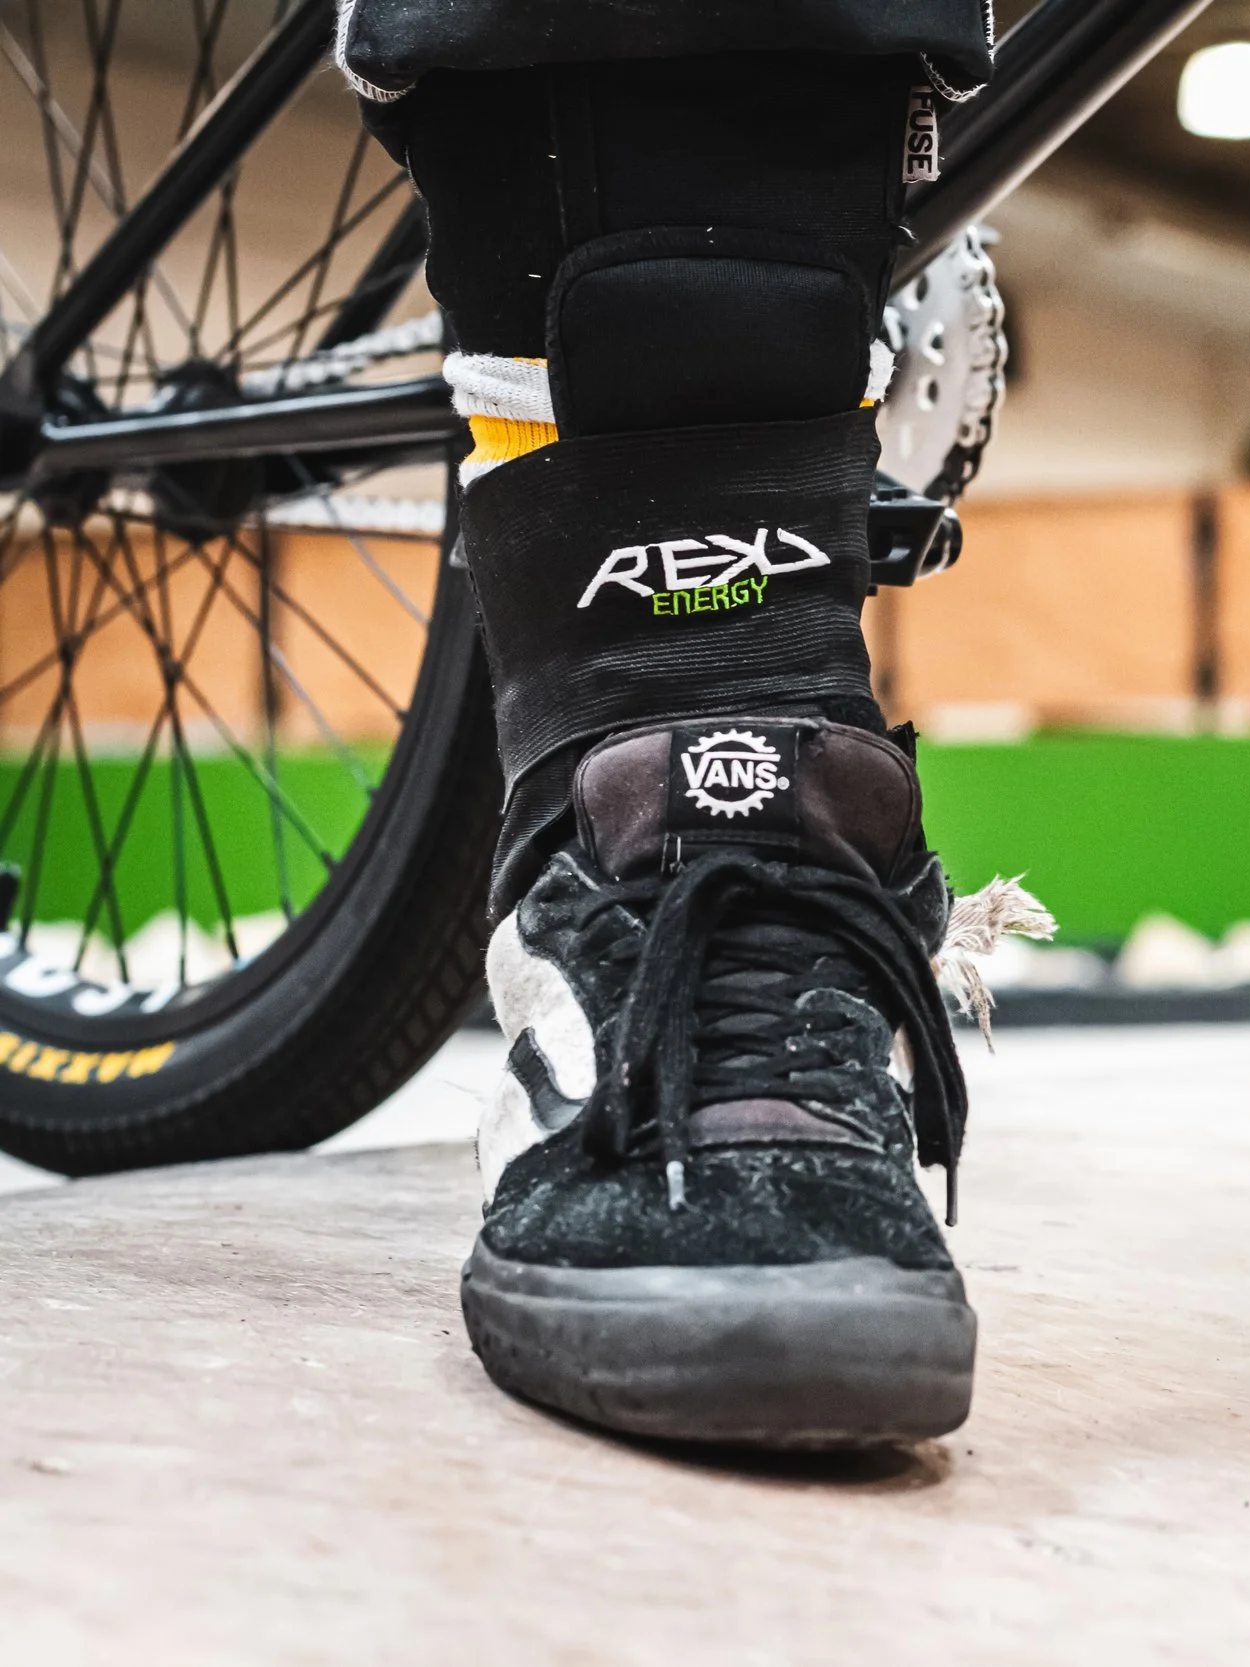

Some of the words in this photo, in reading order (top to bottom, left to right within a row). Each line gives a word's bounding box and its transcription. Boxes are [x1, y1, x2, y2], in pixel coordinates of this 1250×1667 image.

[907, 92, 933, 175] FUSE
[653, 575, 769, 616] ENERGY
[680, 751, 781, 790] VANS
